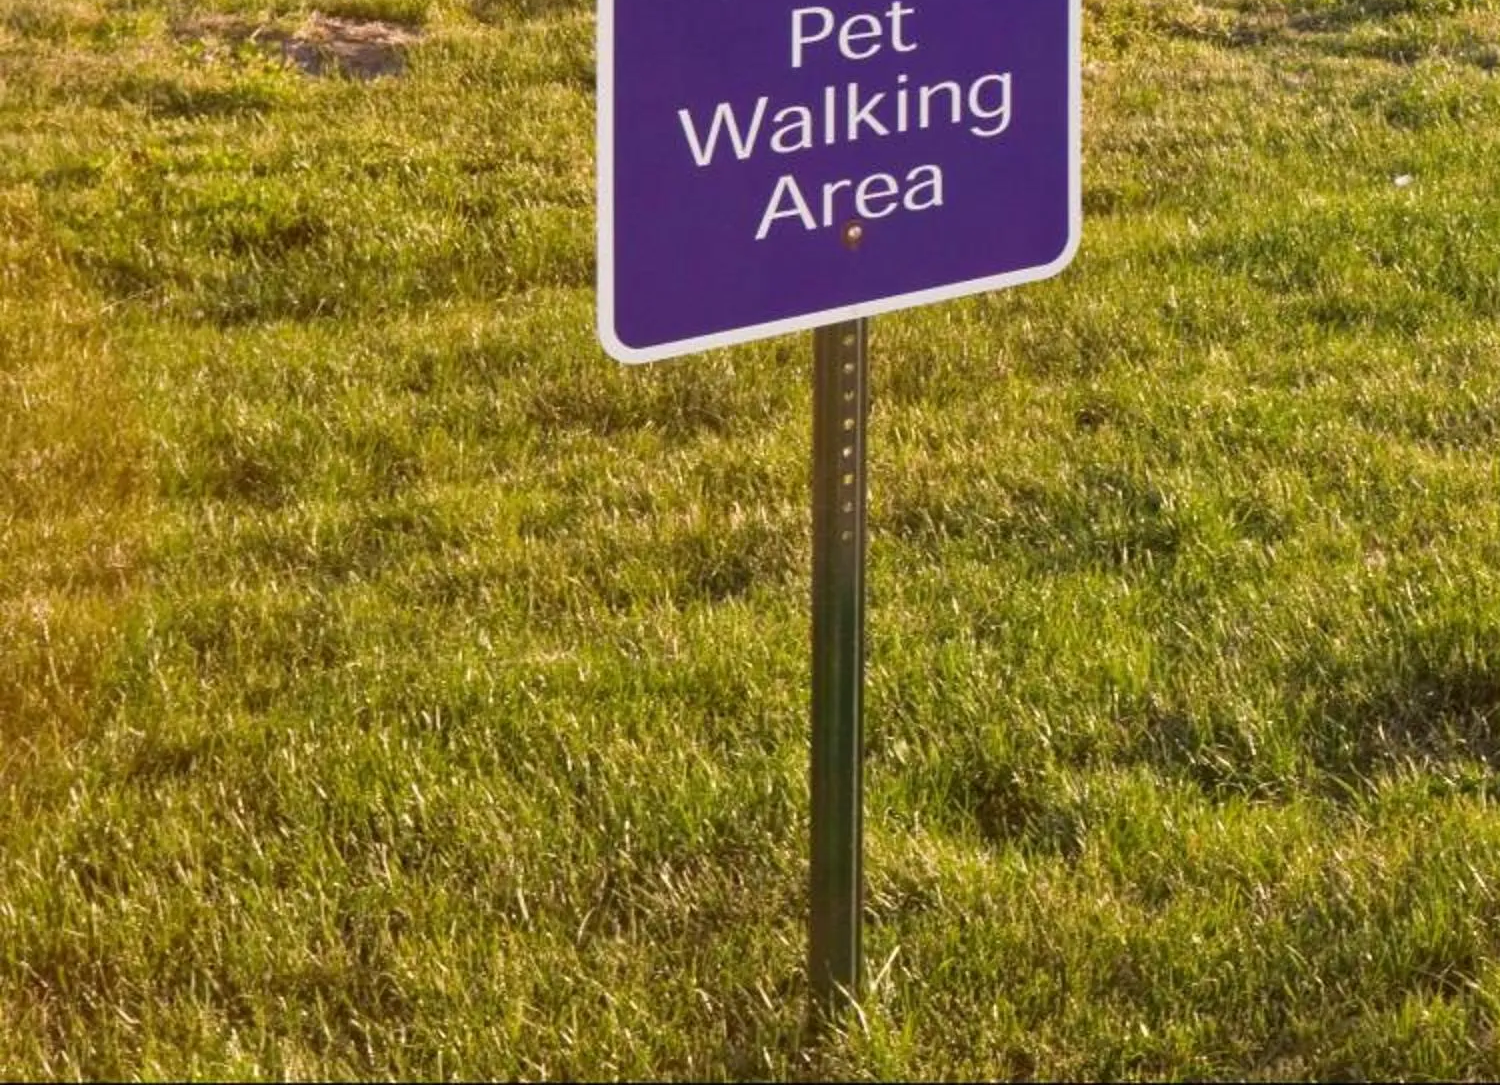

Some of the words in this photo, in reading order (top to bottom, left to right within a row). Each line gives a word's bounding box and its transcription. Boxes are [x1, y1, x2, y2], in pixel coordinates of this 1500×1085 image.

[791, 0, 918, 68] Pet
[677, 71, 1013, 167] Walking
[754, 164, 943, 241] Area
